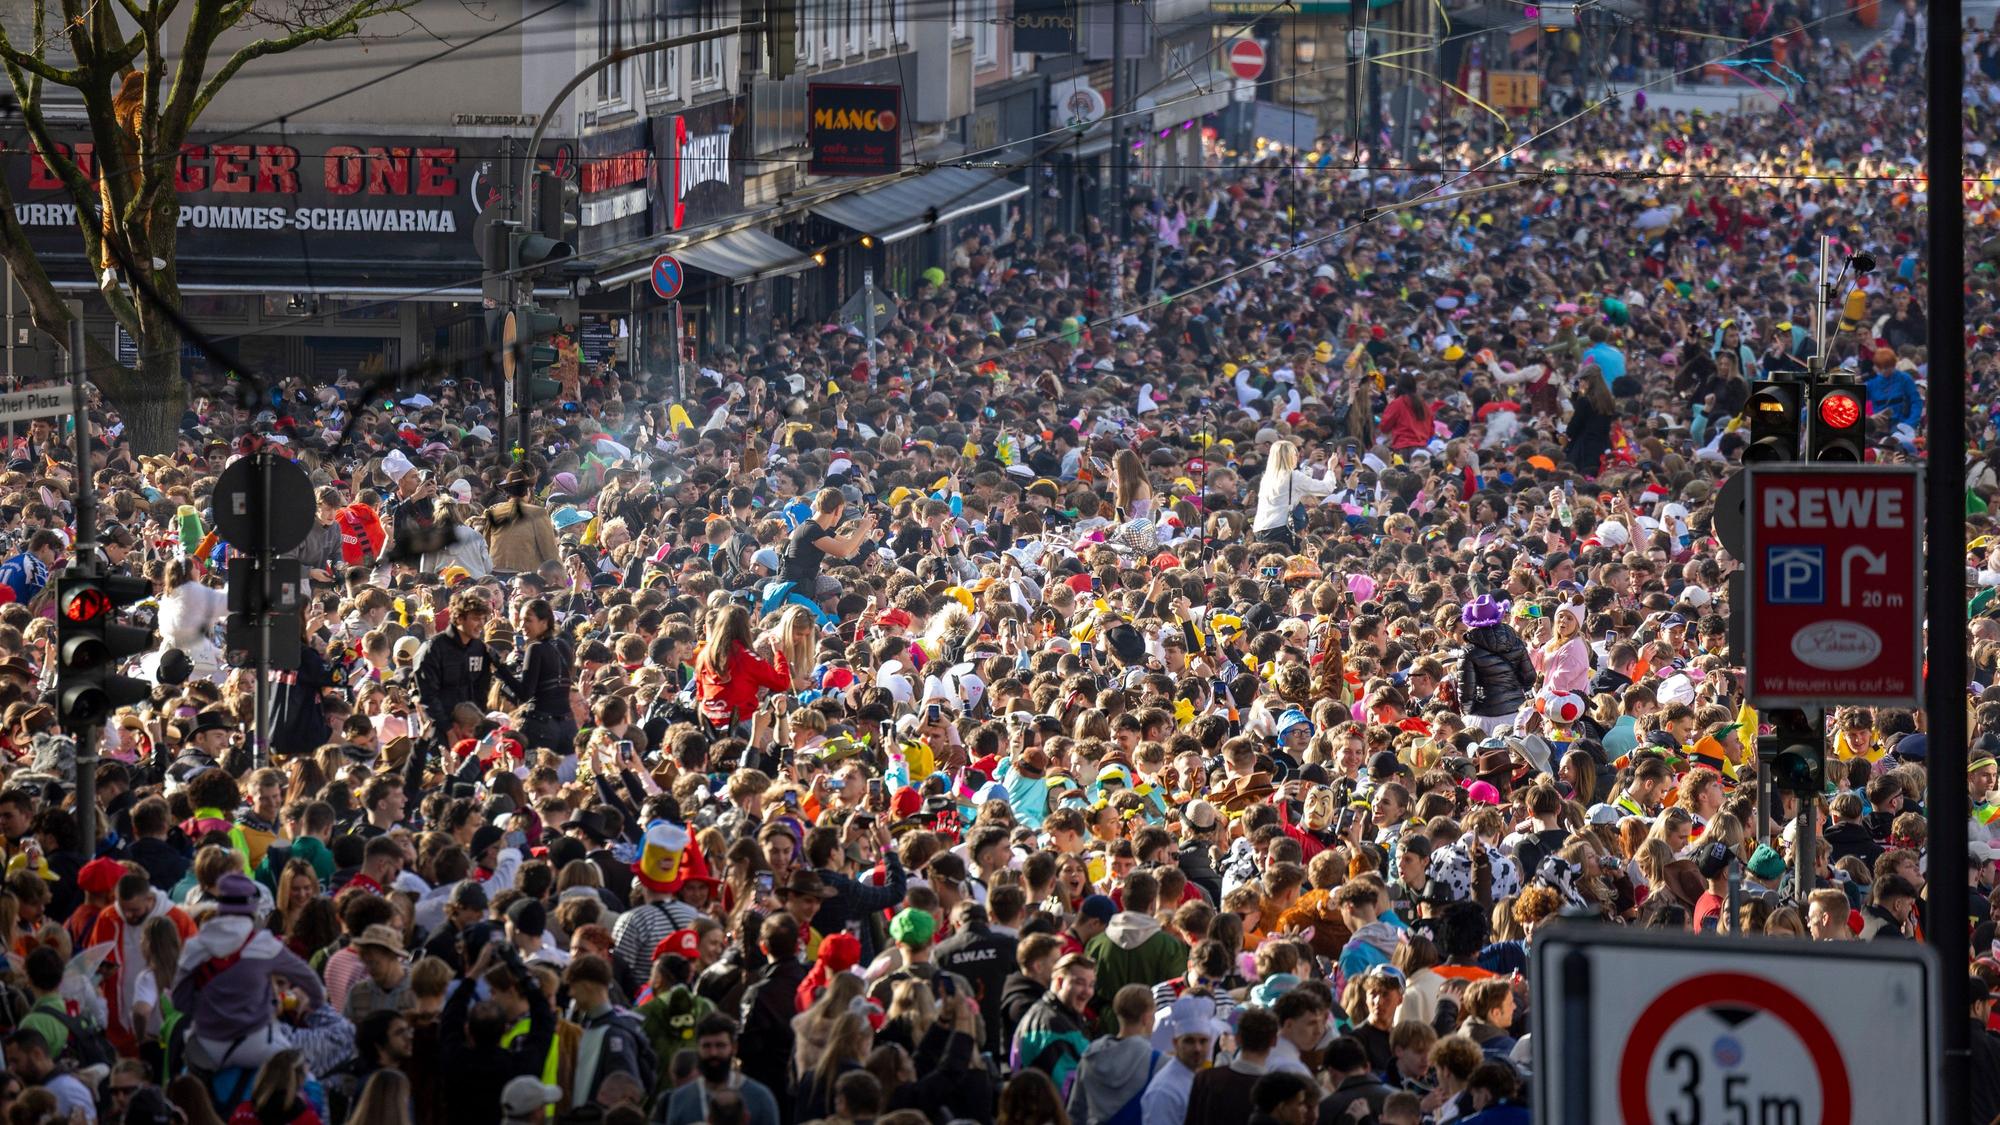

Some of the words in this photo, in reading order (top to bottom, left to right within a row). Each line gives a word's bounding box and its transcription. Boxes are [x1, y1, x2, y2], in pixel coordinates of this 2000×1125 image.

[815, 107, 896, 131] MANGO
[28, 142, 299, 194] BGER
[324, 146, 456, 196] ONE
[681, 131, 730, 199] DÖNERFLIX
[14, 203, 77, 226] URRY
[0, 398, 23, 414] her
[28, 393, 60, 410] Platz
[1764, 487, 1905, 529] REWE
[1862, 592, 1882, 608] 20
[1887, 594, 1903, 608] m
[469, 656, 483, 672] FBI
[1764, 677, 1784, 690] Wir
[1833, 679, 1857, 691] uns
[1860, 677, 1882, 692] auf
